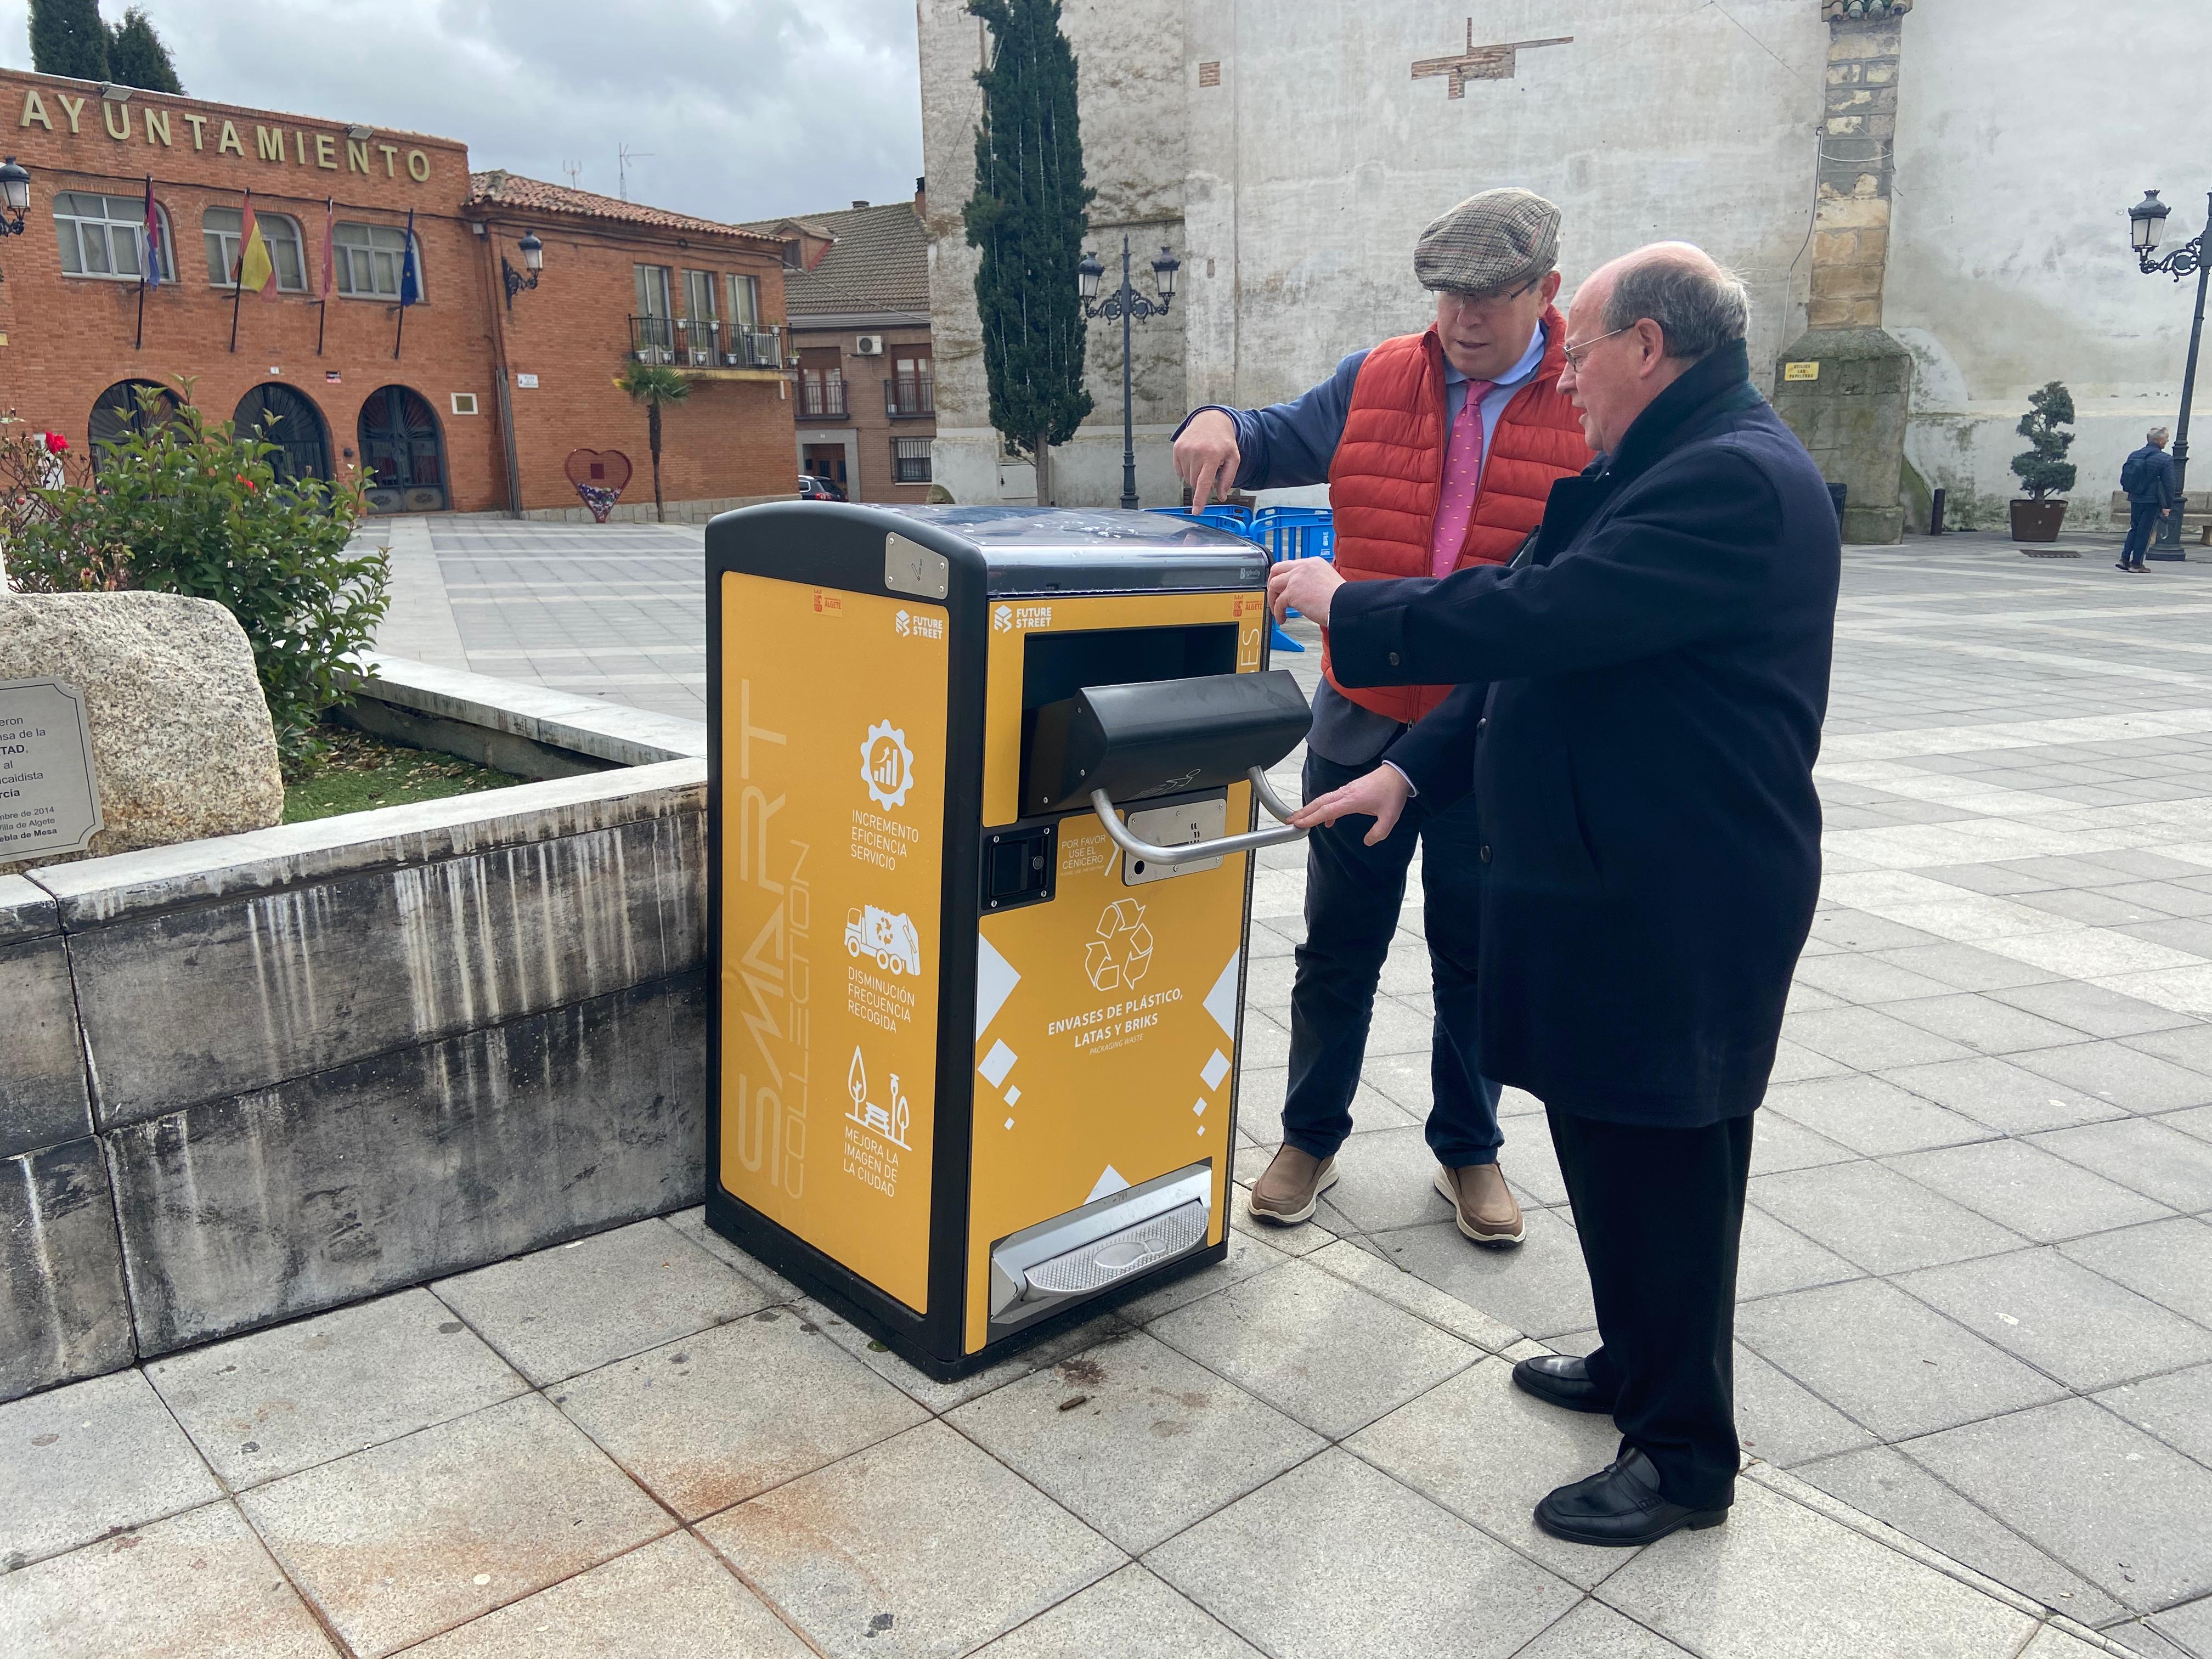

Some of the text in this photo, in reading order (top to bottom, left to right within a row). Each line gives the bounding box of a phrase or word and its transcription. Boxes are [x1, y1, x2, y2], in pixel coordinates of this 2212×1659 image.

[19, 90, 431, 183] AYUNTAMIENTO
[825, 600, 842, 610] ALGETE
[1016, 607, 1052, 618] FUTURE
[913, 615, 943, 630] FUTURE
[913, 625, 943, 640] STREET
[1015, 617, 1052, 628] STREET
[19, 730, 33, 738] de
[36, 728, 46, 736] la
[3, 760, 13, 769] al
[29, 818, 55, 827] Algete
[33, 806, 54, 816] 2014
[33, 828, 58, 837] Mesa
[852, 809, 919, 843] INCREMENTO
[851, 826, 907, 857] EFICIENCIA
[1062, 834, 1106, 850] POR FAVOR
[1069, 846, 1097, 859] USE EL
[851, 843, 895, 871] SERVICIO
[1063, 854, 1104, 870] CENICERO
[737, 679, 787, 1187] SMART
[848, 966, 915, 1007] DISMINUCIÓN
[848, 983, 911, 1024] FRECUENCIA
[848, 999, 897, 1034] RECOGIDA
[1048, 988, 1183, 1036] ENVASES DE PLÁSTICO,
[783, 838, 810, 1200] COLLECTION
[1075, 1013, 1158, 1048] LATAS Y BRIKS
[1088, 1033, 1144, 1057] PACKAGING WASTE
[845, 1125, 899, 1167] MEJORA LA
[845, 1142, 898, 1183] IMAGEN DE
[844, 1158, 894, 1198] LA CIUDAD
